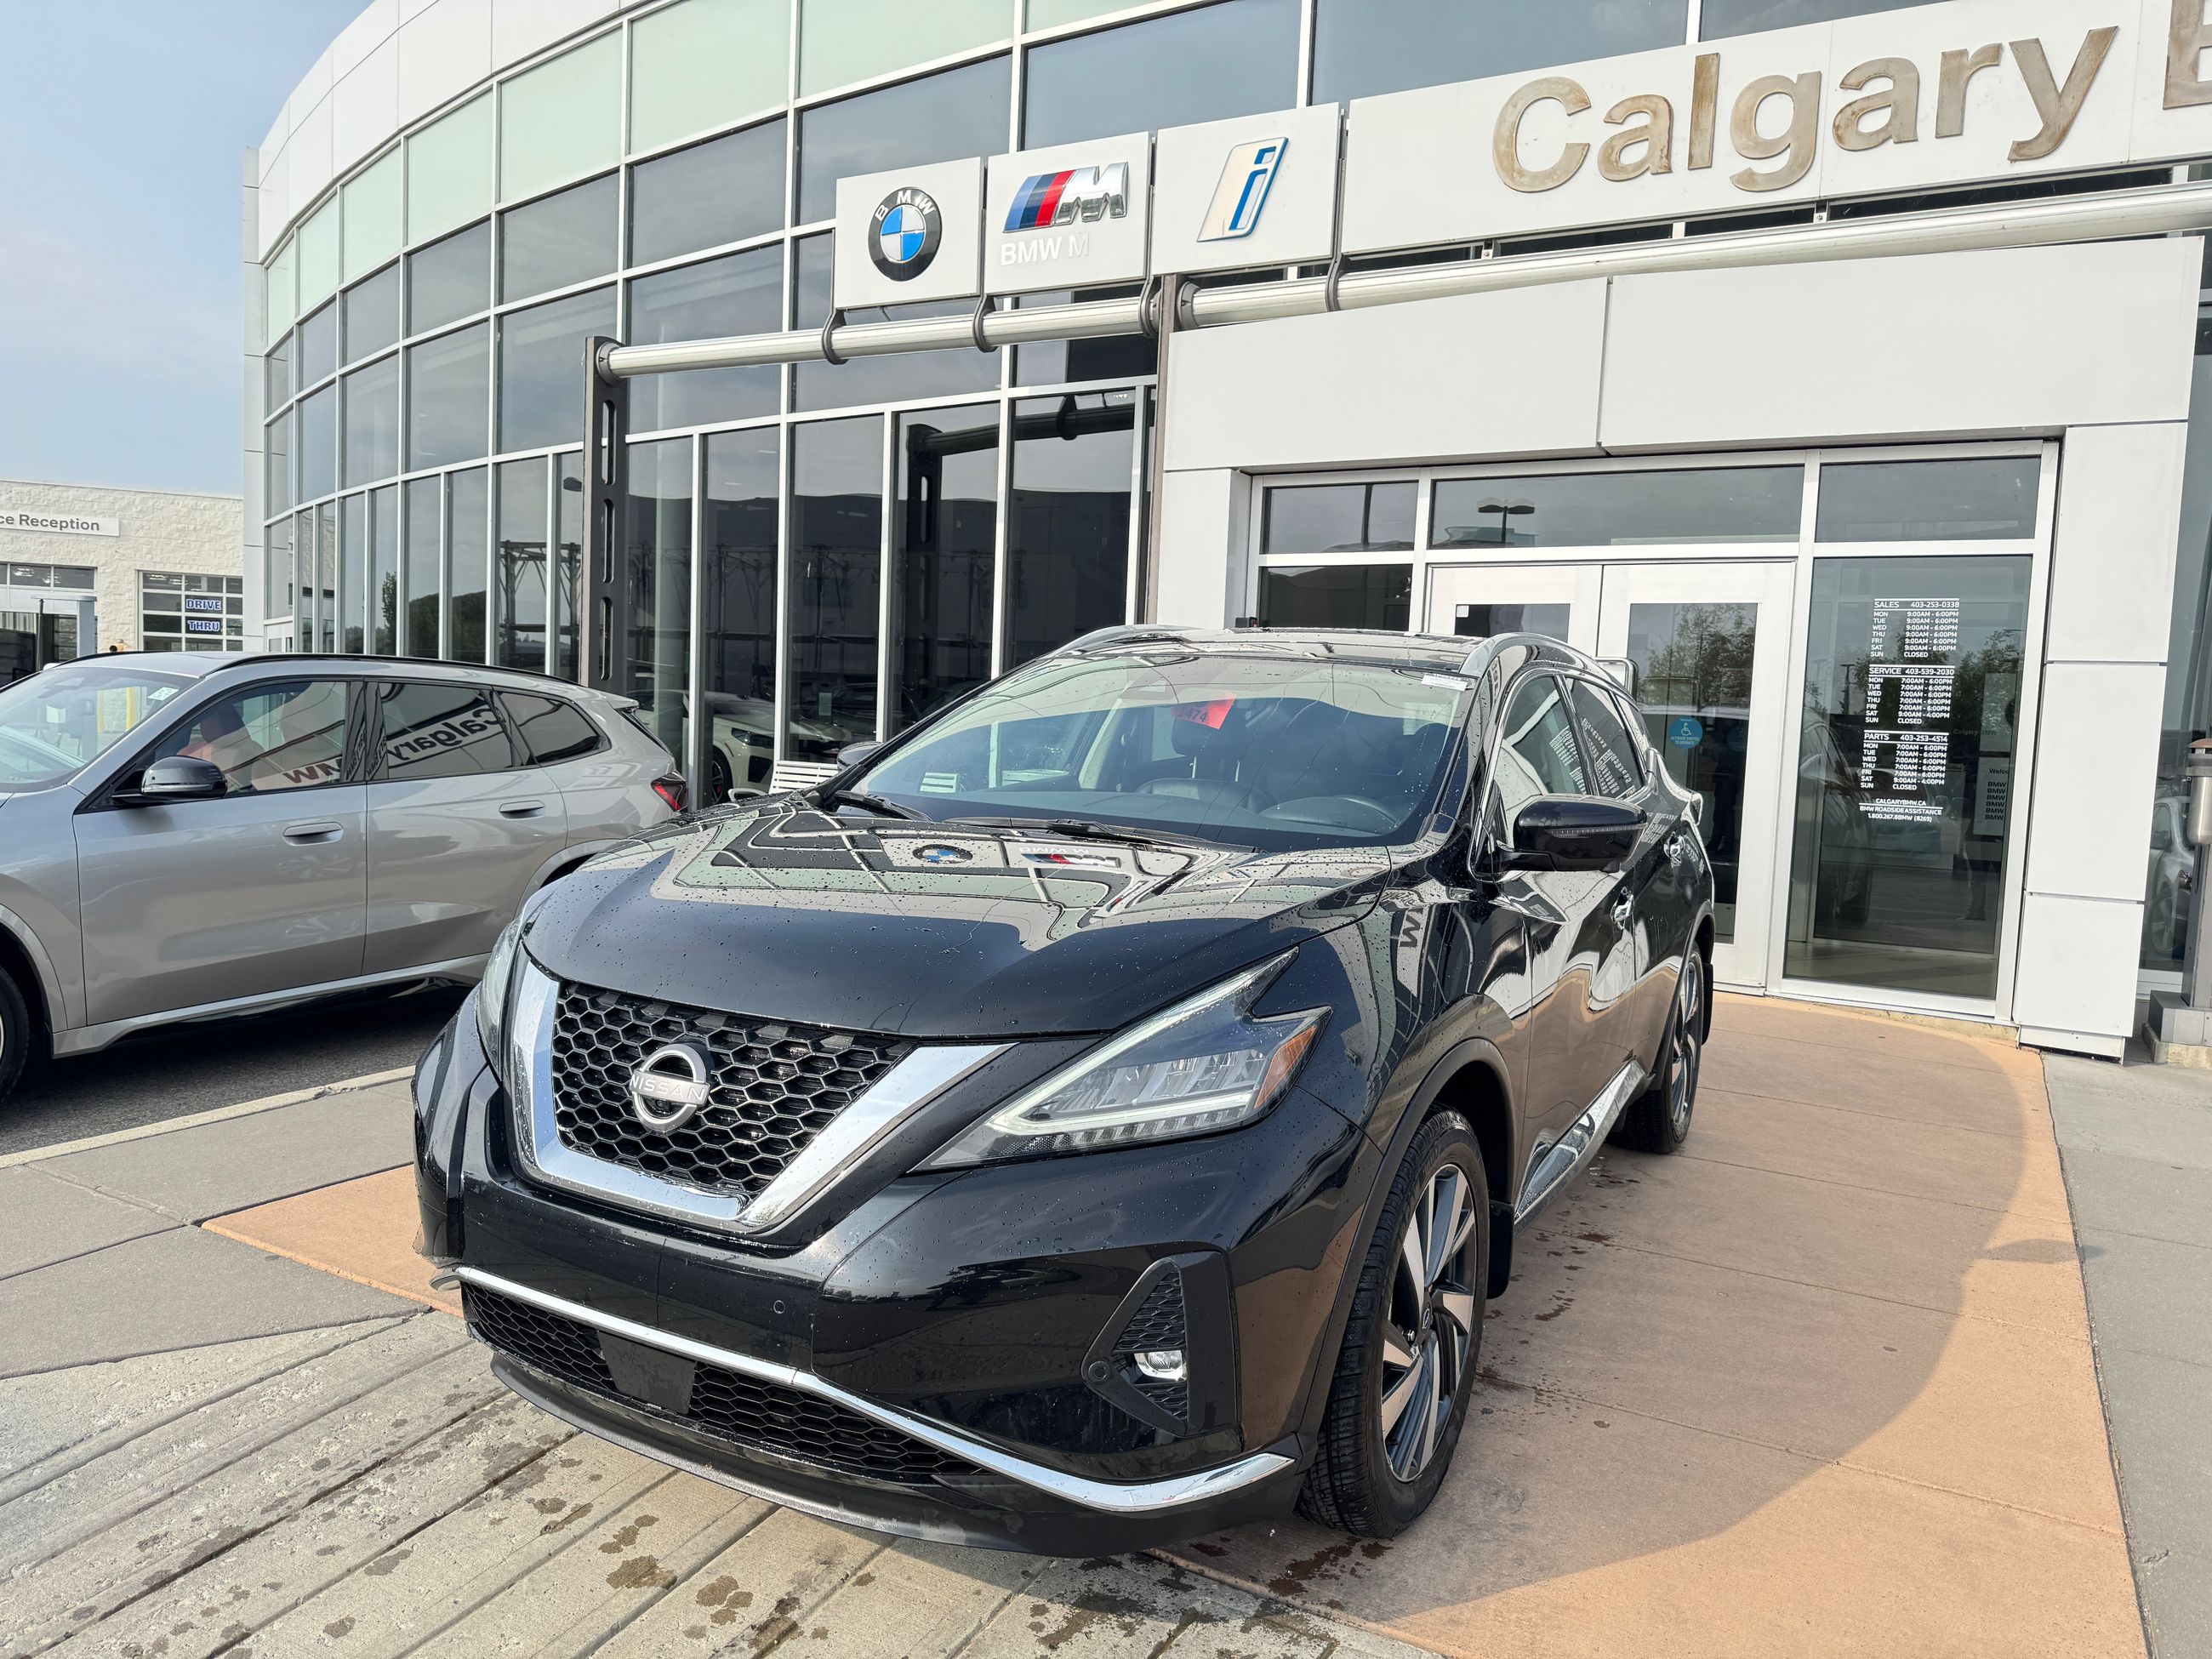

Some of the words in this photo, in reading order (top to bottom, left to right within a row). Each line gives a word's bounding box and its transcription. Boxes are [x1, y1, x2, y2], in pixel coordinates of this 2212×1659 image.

[1492, 26, 2119, 193] Calgary
[875, 190, 935, 221] BMW
[1000, 237, 1063, 265] BMW
[1069, 233, 1090, 258] M
[19, 514, 100, 531] Reception
[186, 599, 222, 611] DRIVE
[187, 619, 220, 632] THRU
[1177, 709, 1208, 722] 474
[629, 1074, 705, 1101] NISSAN
